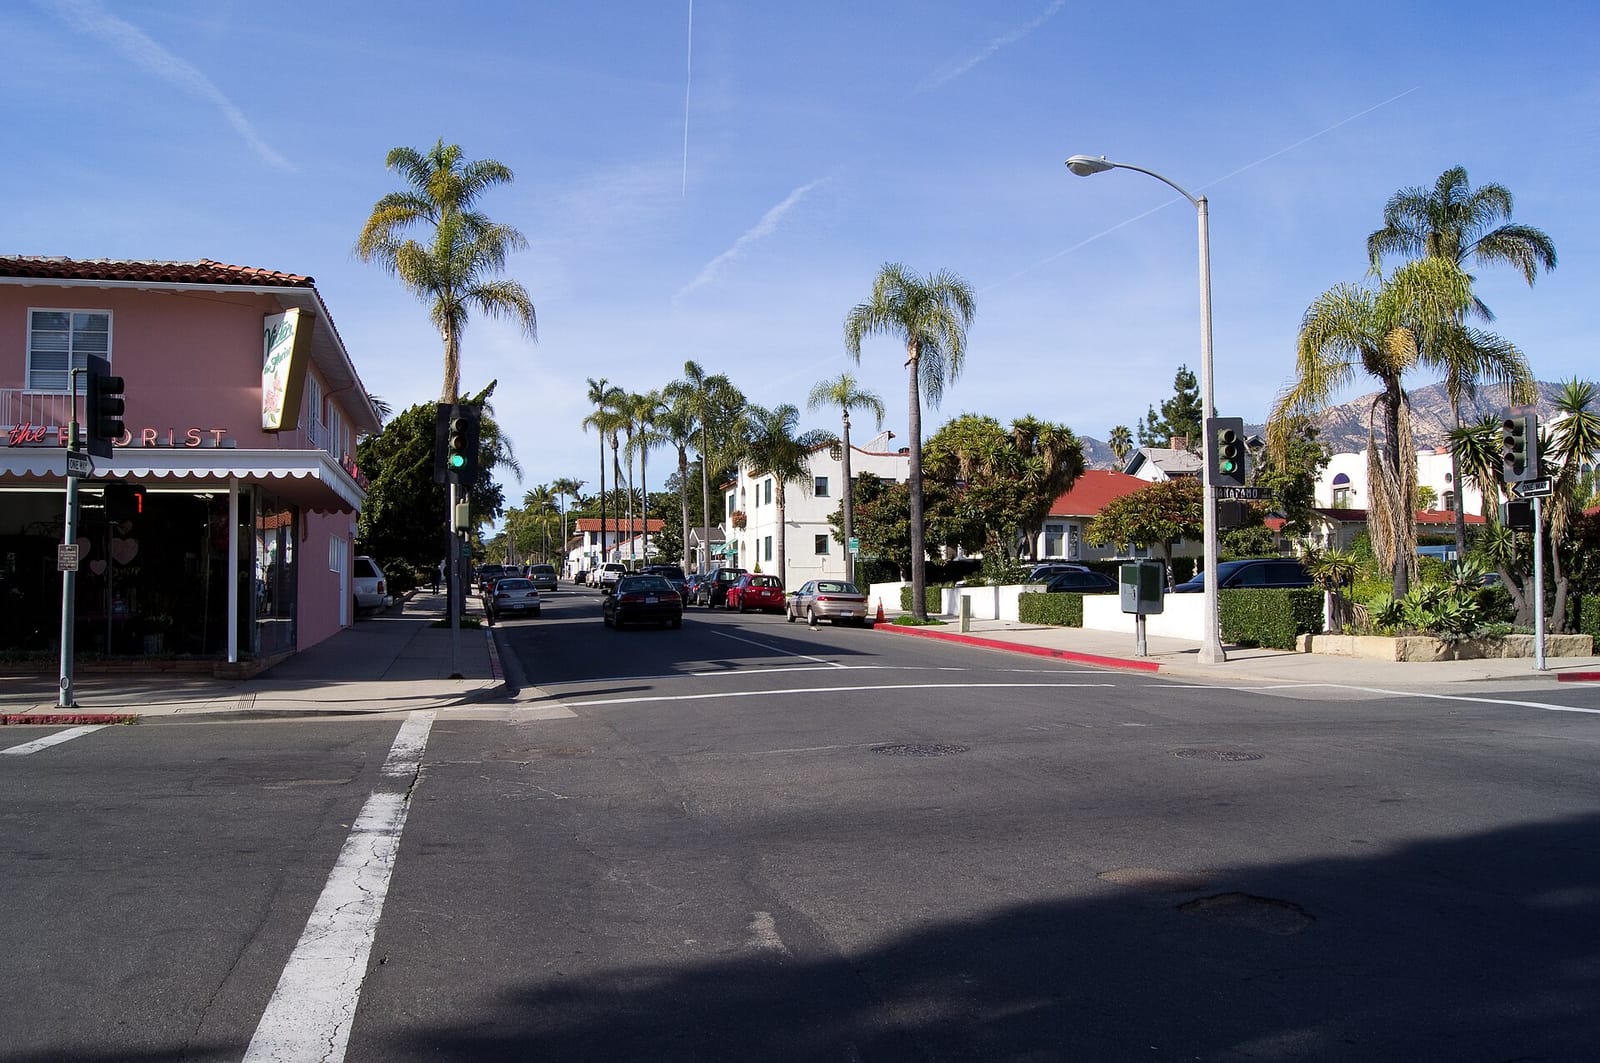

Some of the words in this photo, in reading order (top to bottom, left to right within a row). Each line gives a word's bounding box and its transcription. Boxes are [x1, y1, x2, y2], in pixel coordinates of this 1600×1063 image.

[8, 421, 48, 447] the
[58, 427, 227, 447] FORIST
[70, 459, 79, 470] ONE
[1523, 482, 1535, 491] ONE
[1536, 481, 1548, 490] WAY
